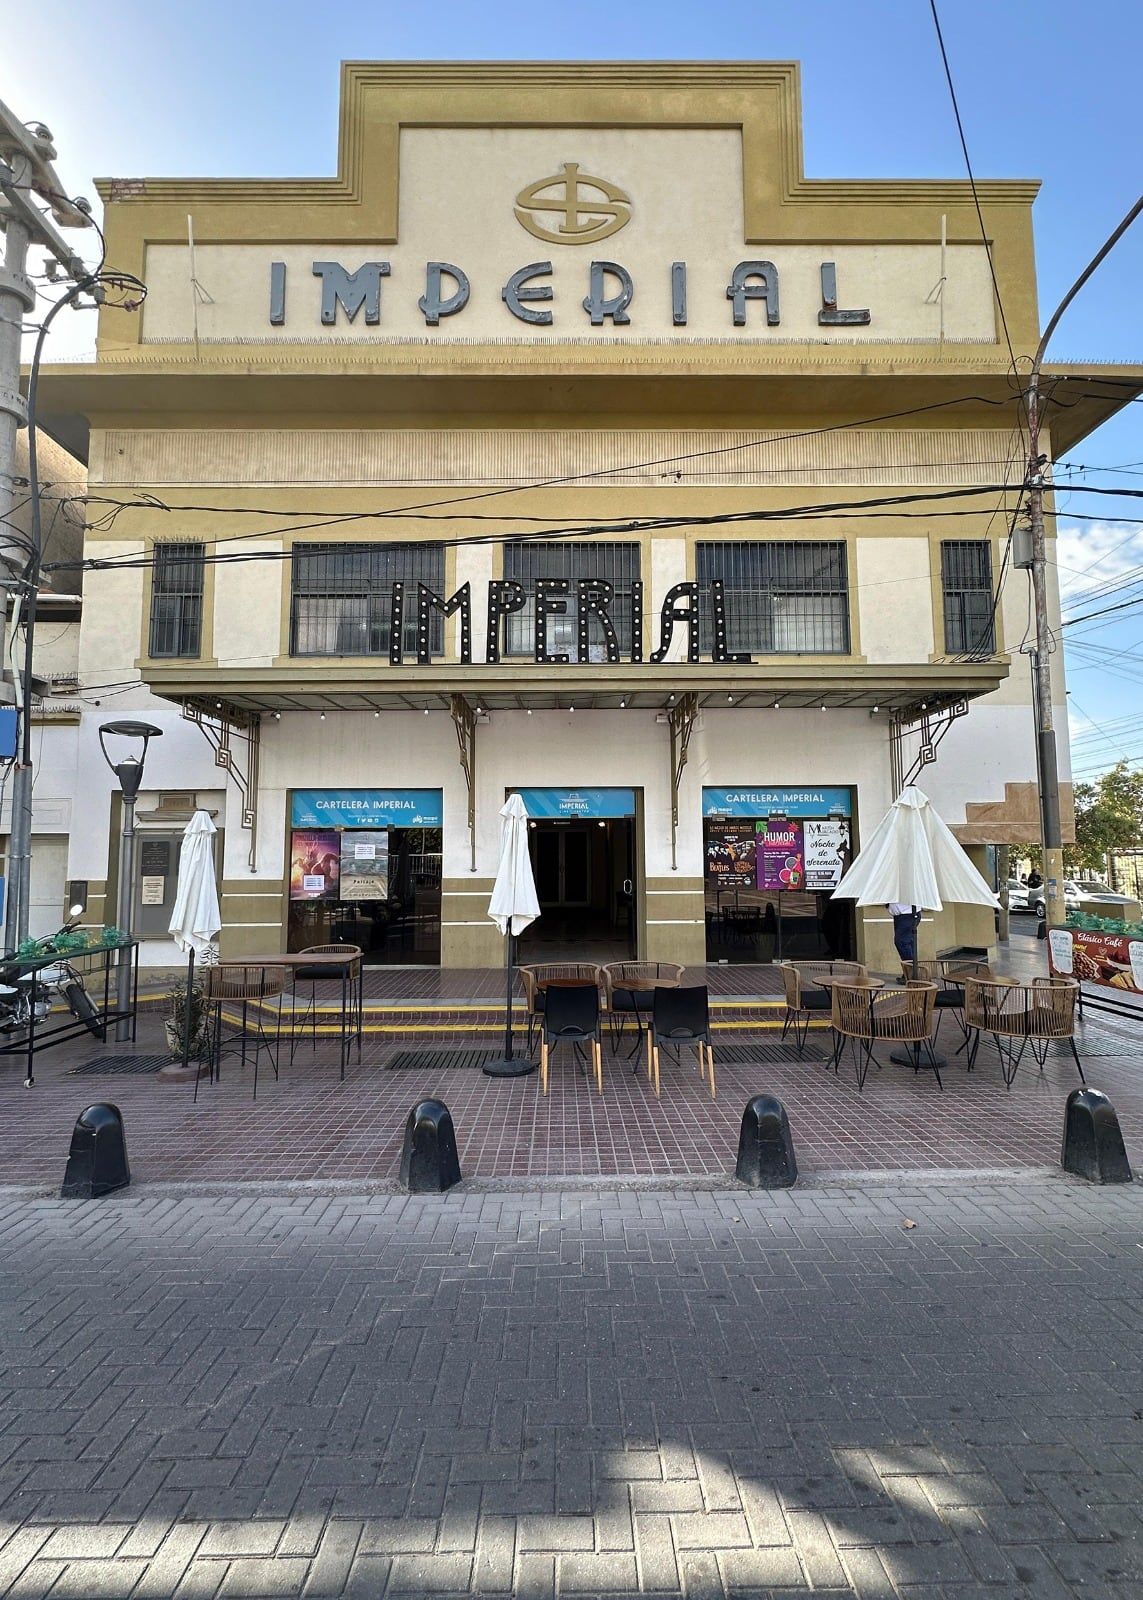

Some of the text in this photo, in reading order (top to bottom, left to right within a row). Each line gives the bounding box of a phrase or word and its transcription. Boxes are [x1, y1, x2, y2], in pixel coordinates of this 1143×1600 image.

[269, 261, 871, 327] IMPERIAL
[389, 579, 752, 665] IMPERIAL
[725, 794, 825, 802] CARTELERA IMPERIAL
[315, 800, 416, 809] CARTELERA IMPERIAL
[764, 832, 796, 841] HUMOR
[810, 839, 836, 848] Noche
[806, 858, 841, 866] Serenata
[1077, 933, 1124, 948] Clásico Café
